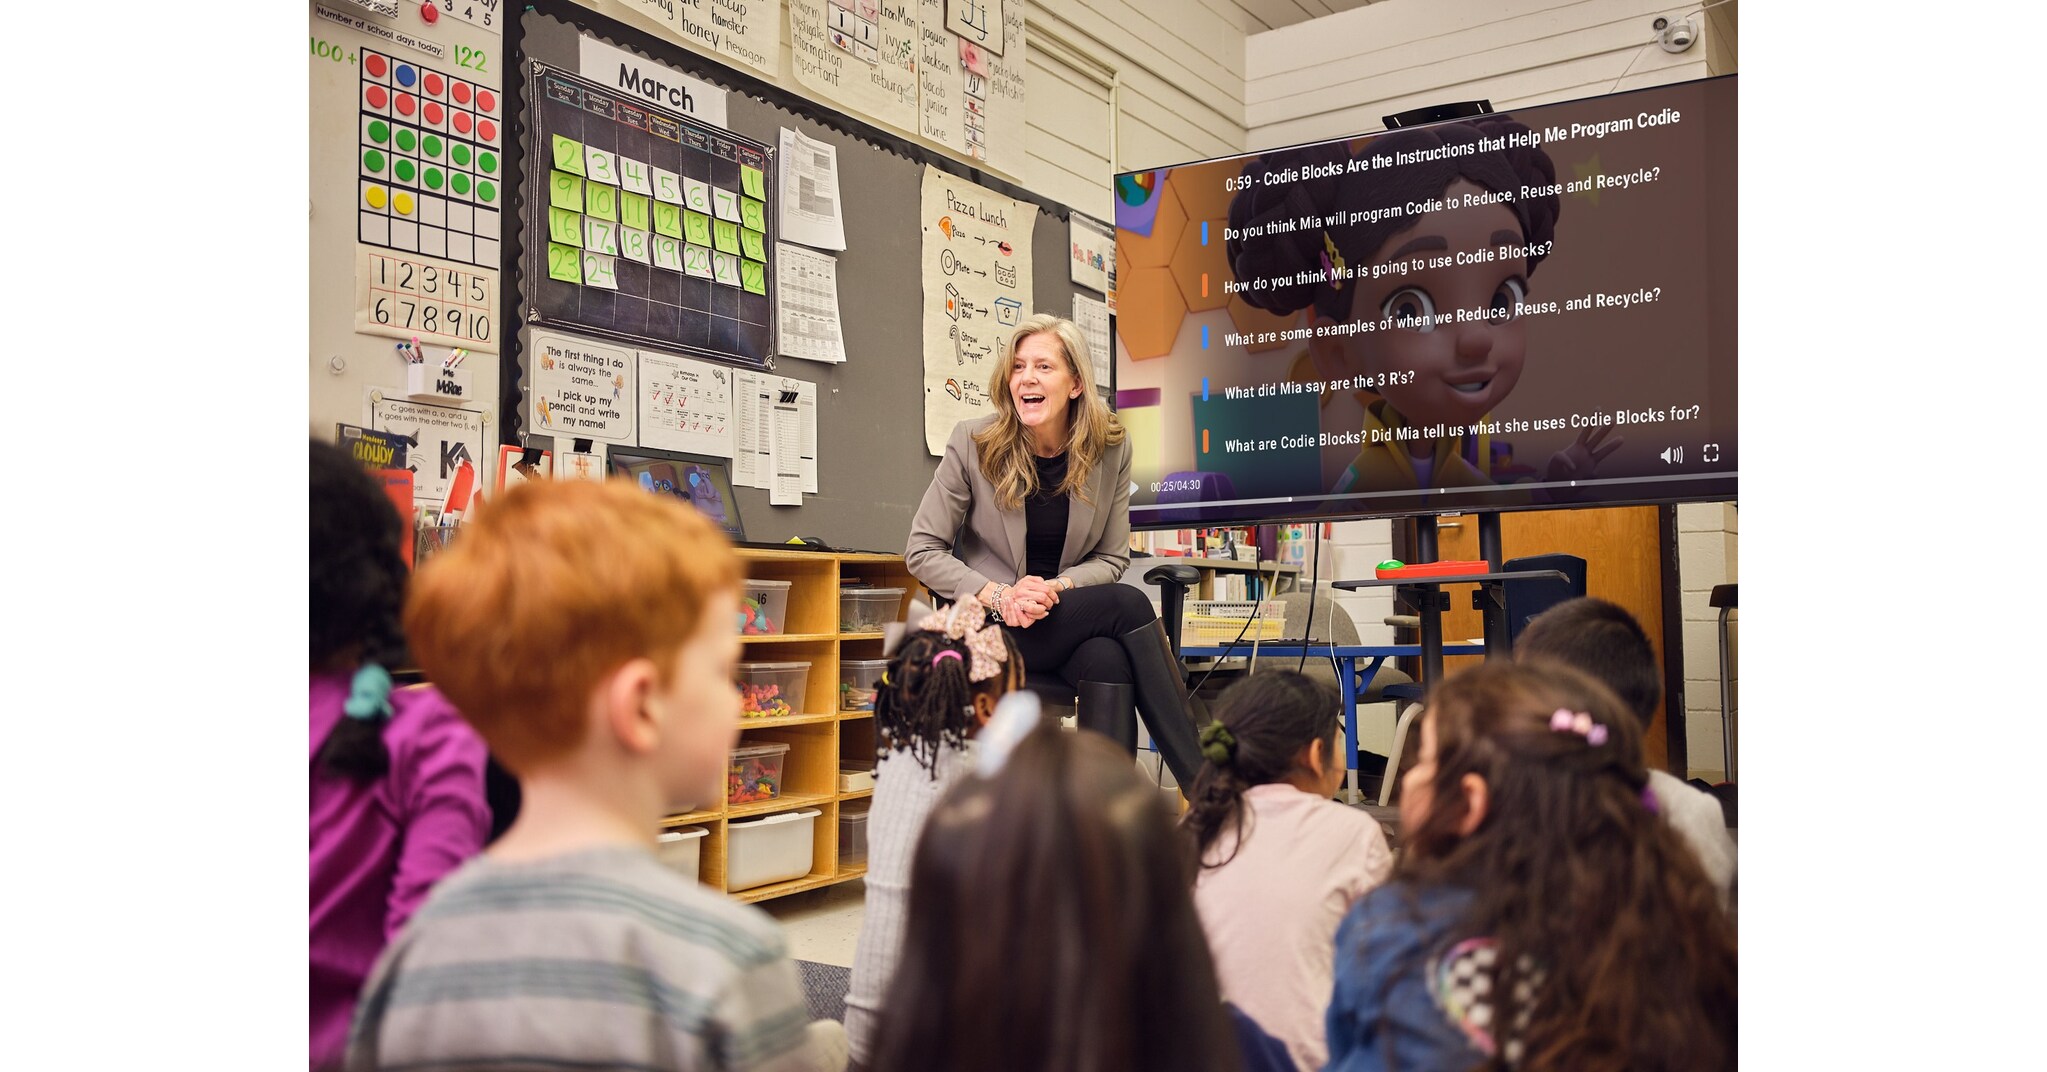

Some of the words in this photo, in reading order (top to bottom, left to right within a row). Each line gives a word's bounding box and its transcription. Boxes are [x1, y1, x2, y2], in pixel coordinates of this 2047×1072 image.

[317, 6, 352, 25] Number
[355, 21, 364, 29] of
[367, 24, 394, 40] school
[396, 34, 416, 48] days
[418, 41, 443, 56] today:
[711, 6, 748, 35] hamster
[682, 8, 719, 49] honey
[726, 35, 766, 65] hexagon
[310, 37, 343, 62] 100
[455, 45, 488, 73] 122
[922, 44, 951, 75] Jackson
[618, 62, 694, 113] March
[924, 114, 947, 141] June
[1226, 175, 1252, 192] 0:59
[1264, 167, 1298, 186] Codie
[1301, 161, 1343, 181] Blocks
[1347, 158, 1369, 175] Are
[1372, 154, 1393, 170] the
[1396, 141, 1475, 166] Instructions
[1478, 135, 1506, 153] that
[1509, 130, 1541, 148] Help
[1544, 126, 1567, 143] Me
[1571, 116, 1633, 139] Program
[1637, 108, 1681, 128] Codie
[560, 140, 579, 171] 2
[591, 153, 611, 180] 3
[626, 161, 642, 188] 4
[661, 176, 676, 199] 5
[689, 186, 704, 207] 6
[717, 193, 732, 218] 7
[744, 203, 760, 230] 8
[557, 177, 573, 202] 9
[590, 187, 611, 214] 10
[657, 206, 677, 232] 12
[686, 214, 706, 240] 13
[716, 224, 735, 249] 14
[743, 233, 761, 255] 15
[947, 189, 975, 217] Pizza
[979, 202, 1007, 228] Lunch
[1224, 228, 1239, 241] Do
[1242, 225, 1263, 241] you
[1267, 218, 1296, 235] think
[1300, 216, 1322, 230] Mia
[1325, 211, 1346, 227] will
[1350, 205, 1402, 225] program
[1406, 197, 1442, 215] Codie
[1446, 196, 1459, 210] to
[1463, 189, 1516, 208] Reduce,
[1520, 181, 1562, 200] Reuse
[1567, 176, 1592, 193] and
[1596, 166, 1660, 189] Recycle?
[952, 225, 966, 238] Pizza
[956, 260, 970, 274] Plate
[1224, 279, 1249, 294] How
[1253, 277, 1268, 290] do
[1271, 276, 1293, 293] you
[1296, 269, 1327, 285] think
[1331, 266, 1353, 281] Mia
[1357, 263, 1369, 277] is
[1372, 259, 1408, 279] going
[1412, 258, 1425, 271] to
[1429, 256, 1452, 269] use
[1456, 248, 1494, 265] Codie
[1499, 240, 1553, 260] Blocks?
[400, 262, 414, 290] 2
[423, 266, 437, 293] 3
[448, 270, 461, 297] 4
[471, 276, 485, 301] 5
[959, 297, 974, 310] Juice
[961, 310, 972, 320] Box
[375, 298, 389, 324] 6
[400, 301, 415, 328] 7
[423, 306, 438, 333] 8
[447, 310, 461, 336] 9
[469, 313, 489, 340] 10
[1225, 333, 1254, 347] What
[1258, 332, 1277, 343] are
[1280, 328, 1313, 341] some
[1316, 320, 1376, 337] examples
[1379, 316, 1393, 330] of
[1396, 313, 1430, 328] when
[1434, 312, 1453, 324] we
[1456, 307, 1510, 322] Reduce,
[1515, 300, 1561, 316] Reuse,
[1565, 294, 1592, 311] and
[1596, 287, 1661, 307] Recycle?
[961, 331, 978, 344] Straw
[547, 346, 561, 357] The
[565, 350, 580, 360] first
[583, 353, 604, 366] thing
[612, 359, 624, 368] do
[559, 361, 565, 369] is
[568, 362, 596, 375] always
[599, 368, 611, 378] the
[436, 379, 462, 396] McRae
[572, 376, 598, 388] same...
[963, 380, 979, 391] Extra
[1225, 386, 1254, 400] What
[1258, 382, 1277, 397] did
[1280, 380, 1302, 395] Mia
[1305, 380, 1326, 396] say
[1330, 379, 1350, 390] are
[1354, 374, 1374, 389] the
[1377, 373, 1385, 386] 3
[1389, 370, 1415, 385] R's?
[548, 401, 575, 413] pencil
[578, 406, 595, 415] and
[598, 409, 620, 419] write
[563, 390, 581, 402] pick
[584, 395, 596, 404] up
[599, 397, 612, 408] my
[964, 393, 981, 407] Pizza
[384, 412, 402, 421] goes
[403, 414, 417, 423] with
[419, 416, 430, 425] the
[431, 418, 449, 427] other
[450, 420, 463, 429] two
[563, 416, 576, 427] my
[578, 419, 606, 429] name!
[1225, 439, 1255, 453] What
[1258, 438, 1277, 450] are
[1280, 434, 1315, 449] Codie
[1319, 430, 1367, 446] Blocks?
[1371, 428, 1392, 442] Did
[1396, 426, 1419, 440] Mia
[1423, 424, 1444, 438] tell
[1448, 424, 1464, 436] us
[1468, 421, 1501, 435] what
[1505, 417, 1529, 433] she
[1533, 417, 1566, 431] uses
[1571, 412, 1611, 428] Codie
[1616, 408, 1665, 425] Blocks
[1670, 405, 1700, 421] for?
[353, 441, 394, 465] CLOUDY
[1150, 480, 1200, 493] 00:25/04:30
[757, 593, 767, 605] 16
